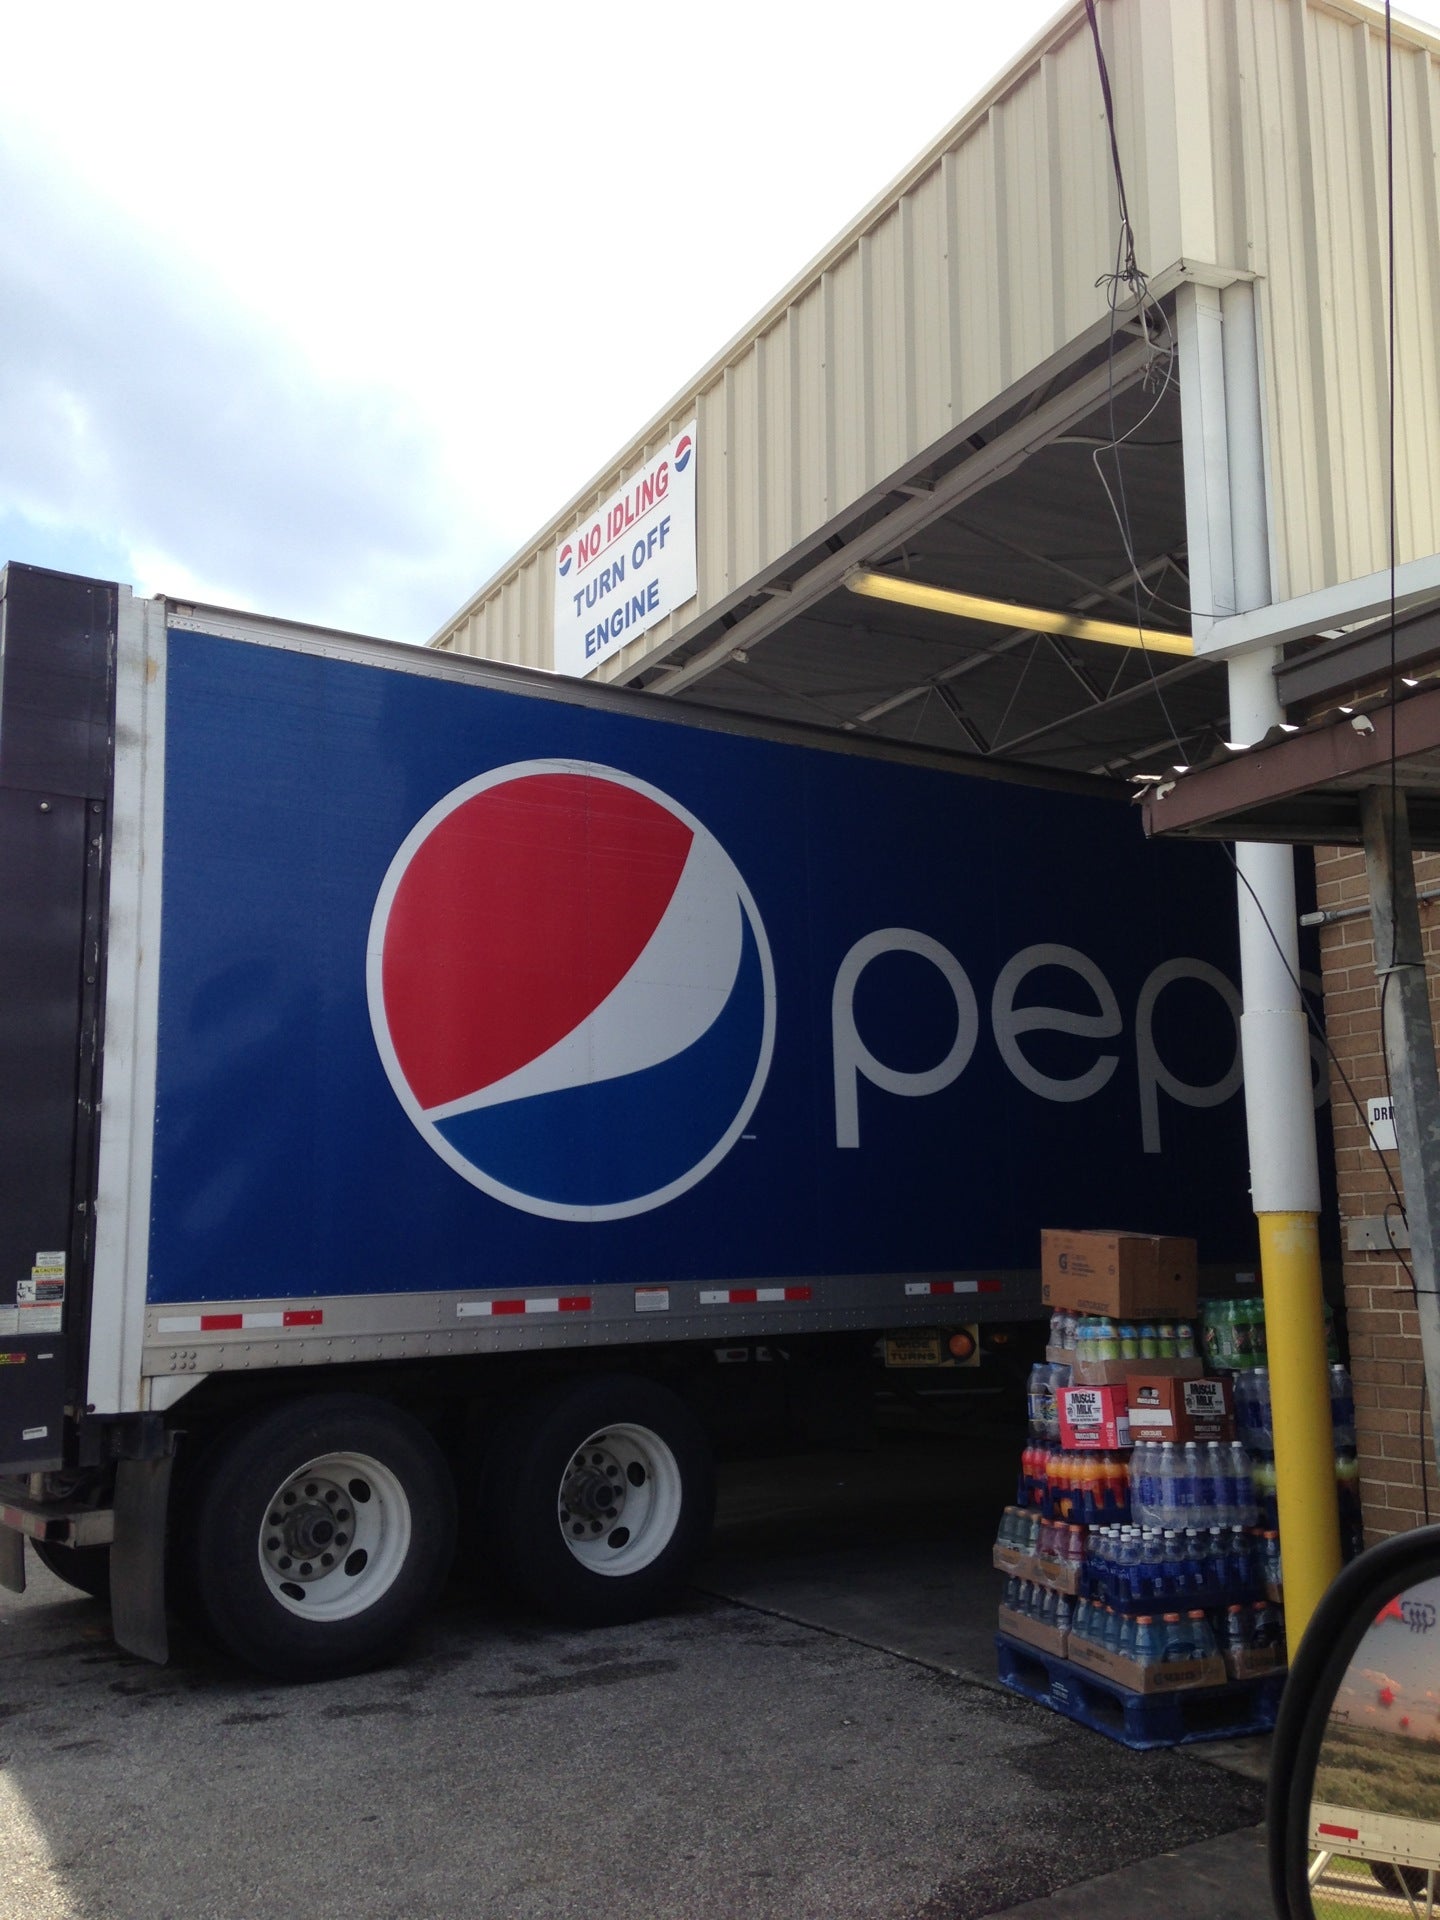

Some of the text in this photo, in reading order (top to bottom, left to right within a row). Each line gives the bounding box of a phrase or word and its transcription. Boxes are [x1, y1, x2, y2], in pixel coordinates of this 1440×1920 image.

[577, 461, 669, 568] NO IDLING
[573, 515, 671, 617] TURN OFF
[585, 578, 660, 659] ENGINE
[1190, 1383, 1217, 1395] MUSCLE
[1071, 1393, 1096, 1404] MUSCLE
[1196, 1395, 1213, 1406] MILK
[1076, 1404, 1092, 1415] MILK
